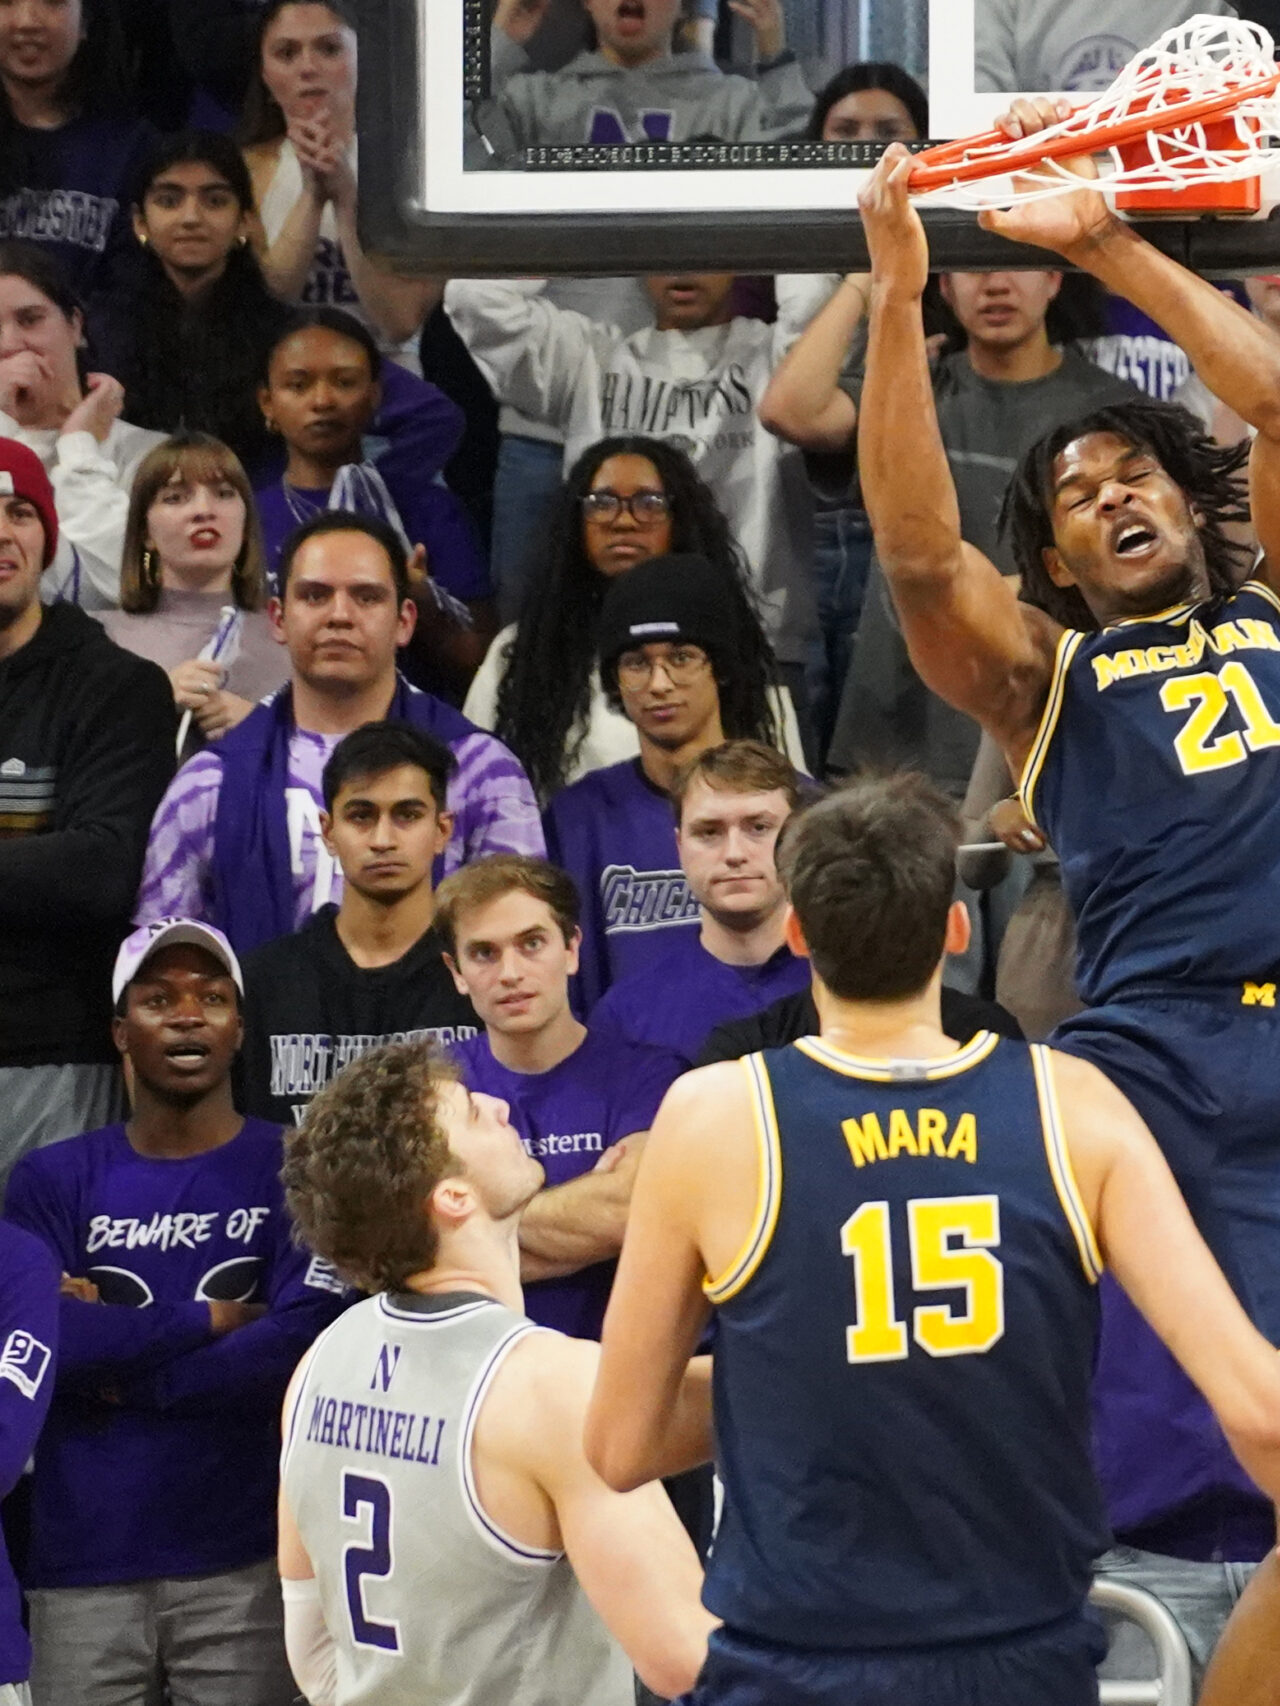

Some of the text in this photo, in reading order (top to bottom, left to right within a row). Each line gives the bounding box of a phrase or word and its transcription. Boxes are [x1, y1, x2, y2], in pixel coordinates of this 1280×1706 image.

[1241, 981, 1276, 1007] M
[841, 1107, 977, 1169] MARA
[85, 1206, 271, 1254] BEWARE OF
[840, 1194, 1005, 1364] 15
[370, 1340, 402, 1393] N
[306, 1394, 446, 1467] MARTINELLI
[340, 1466, 404, 1656] 2
